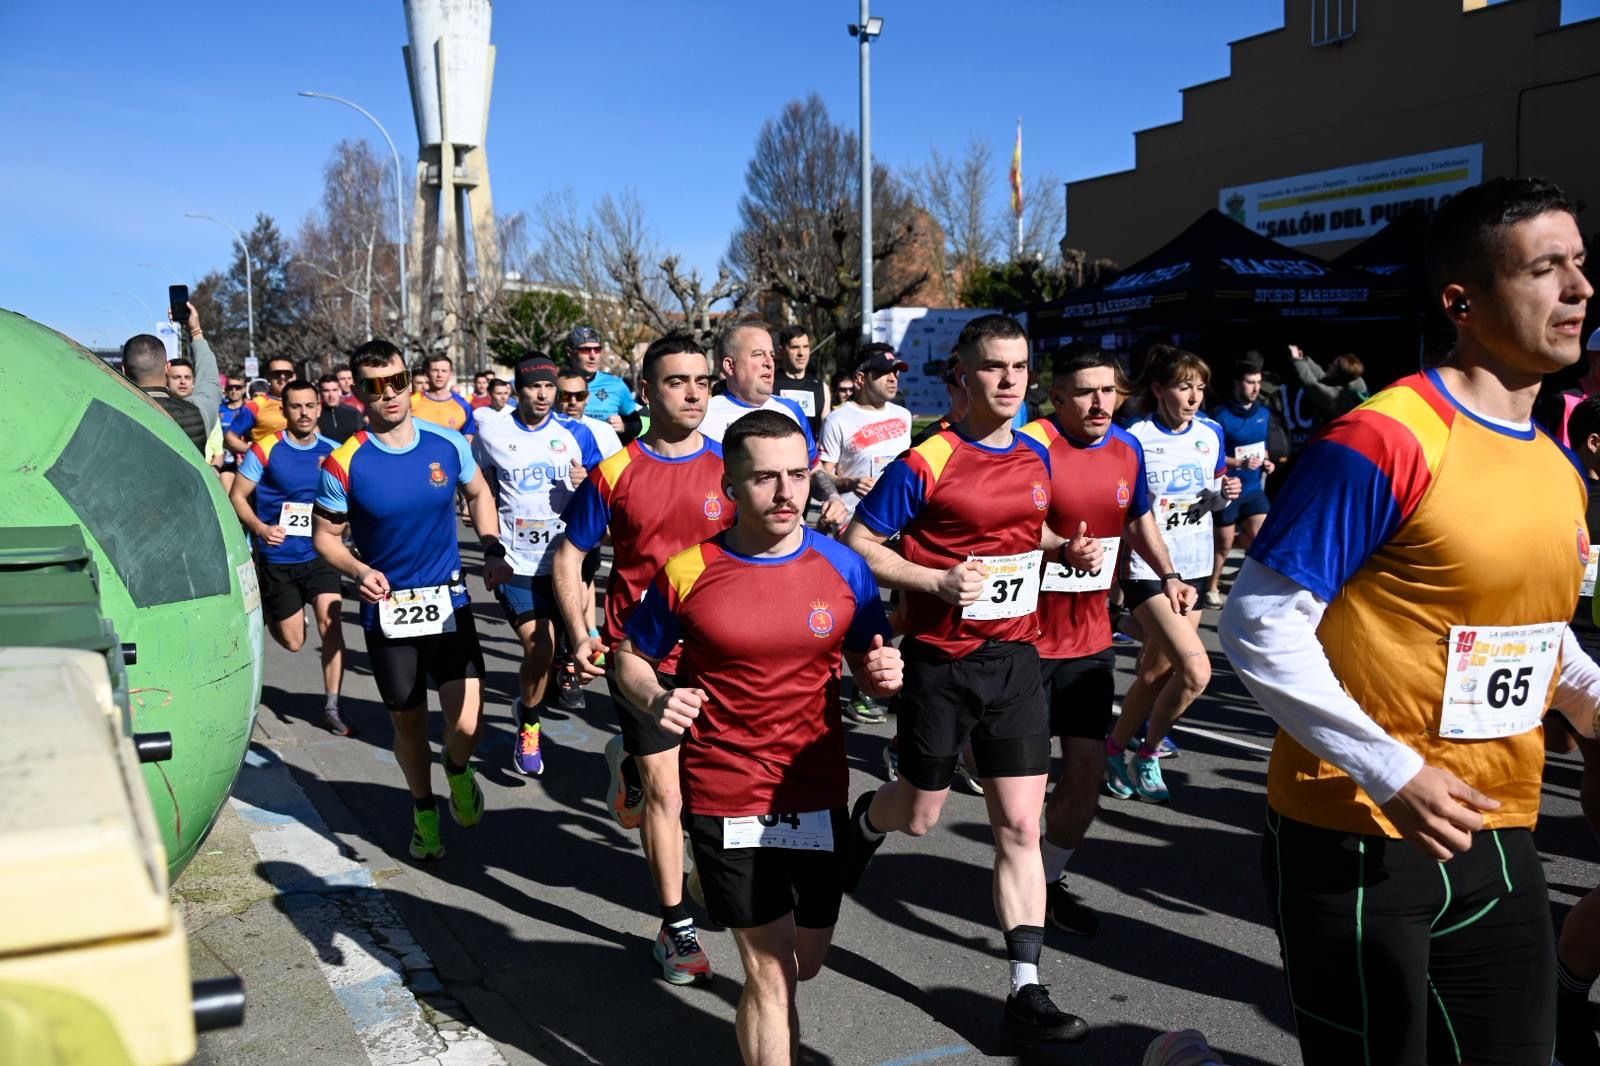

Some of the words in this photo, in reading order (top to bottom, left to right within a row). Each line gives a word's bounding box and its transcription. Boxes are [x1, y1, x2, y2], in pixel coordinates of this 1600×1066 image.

[1256, 211, 1324, 239] "SALÓN
[1330, 208, 1365, 231] DEL
[1254, 288, 1294, 303] SPORTS
[1297, 288, 1369, 303] BARBERSHOP
[529, 530, 550, 544] 31
[991, 577, 1024, 603] 37
[393, 604, 440, 625] 228
[1487, 666, 1533, 709] 65
